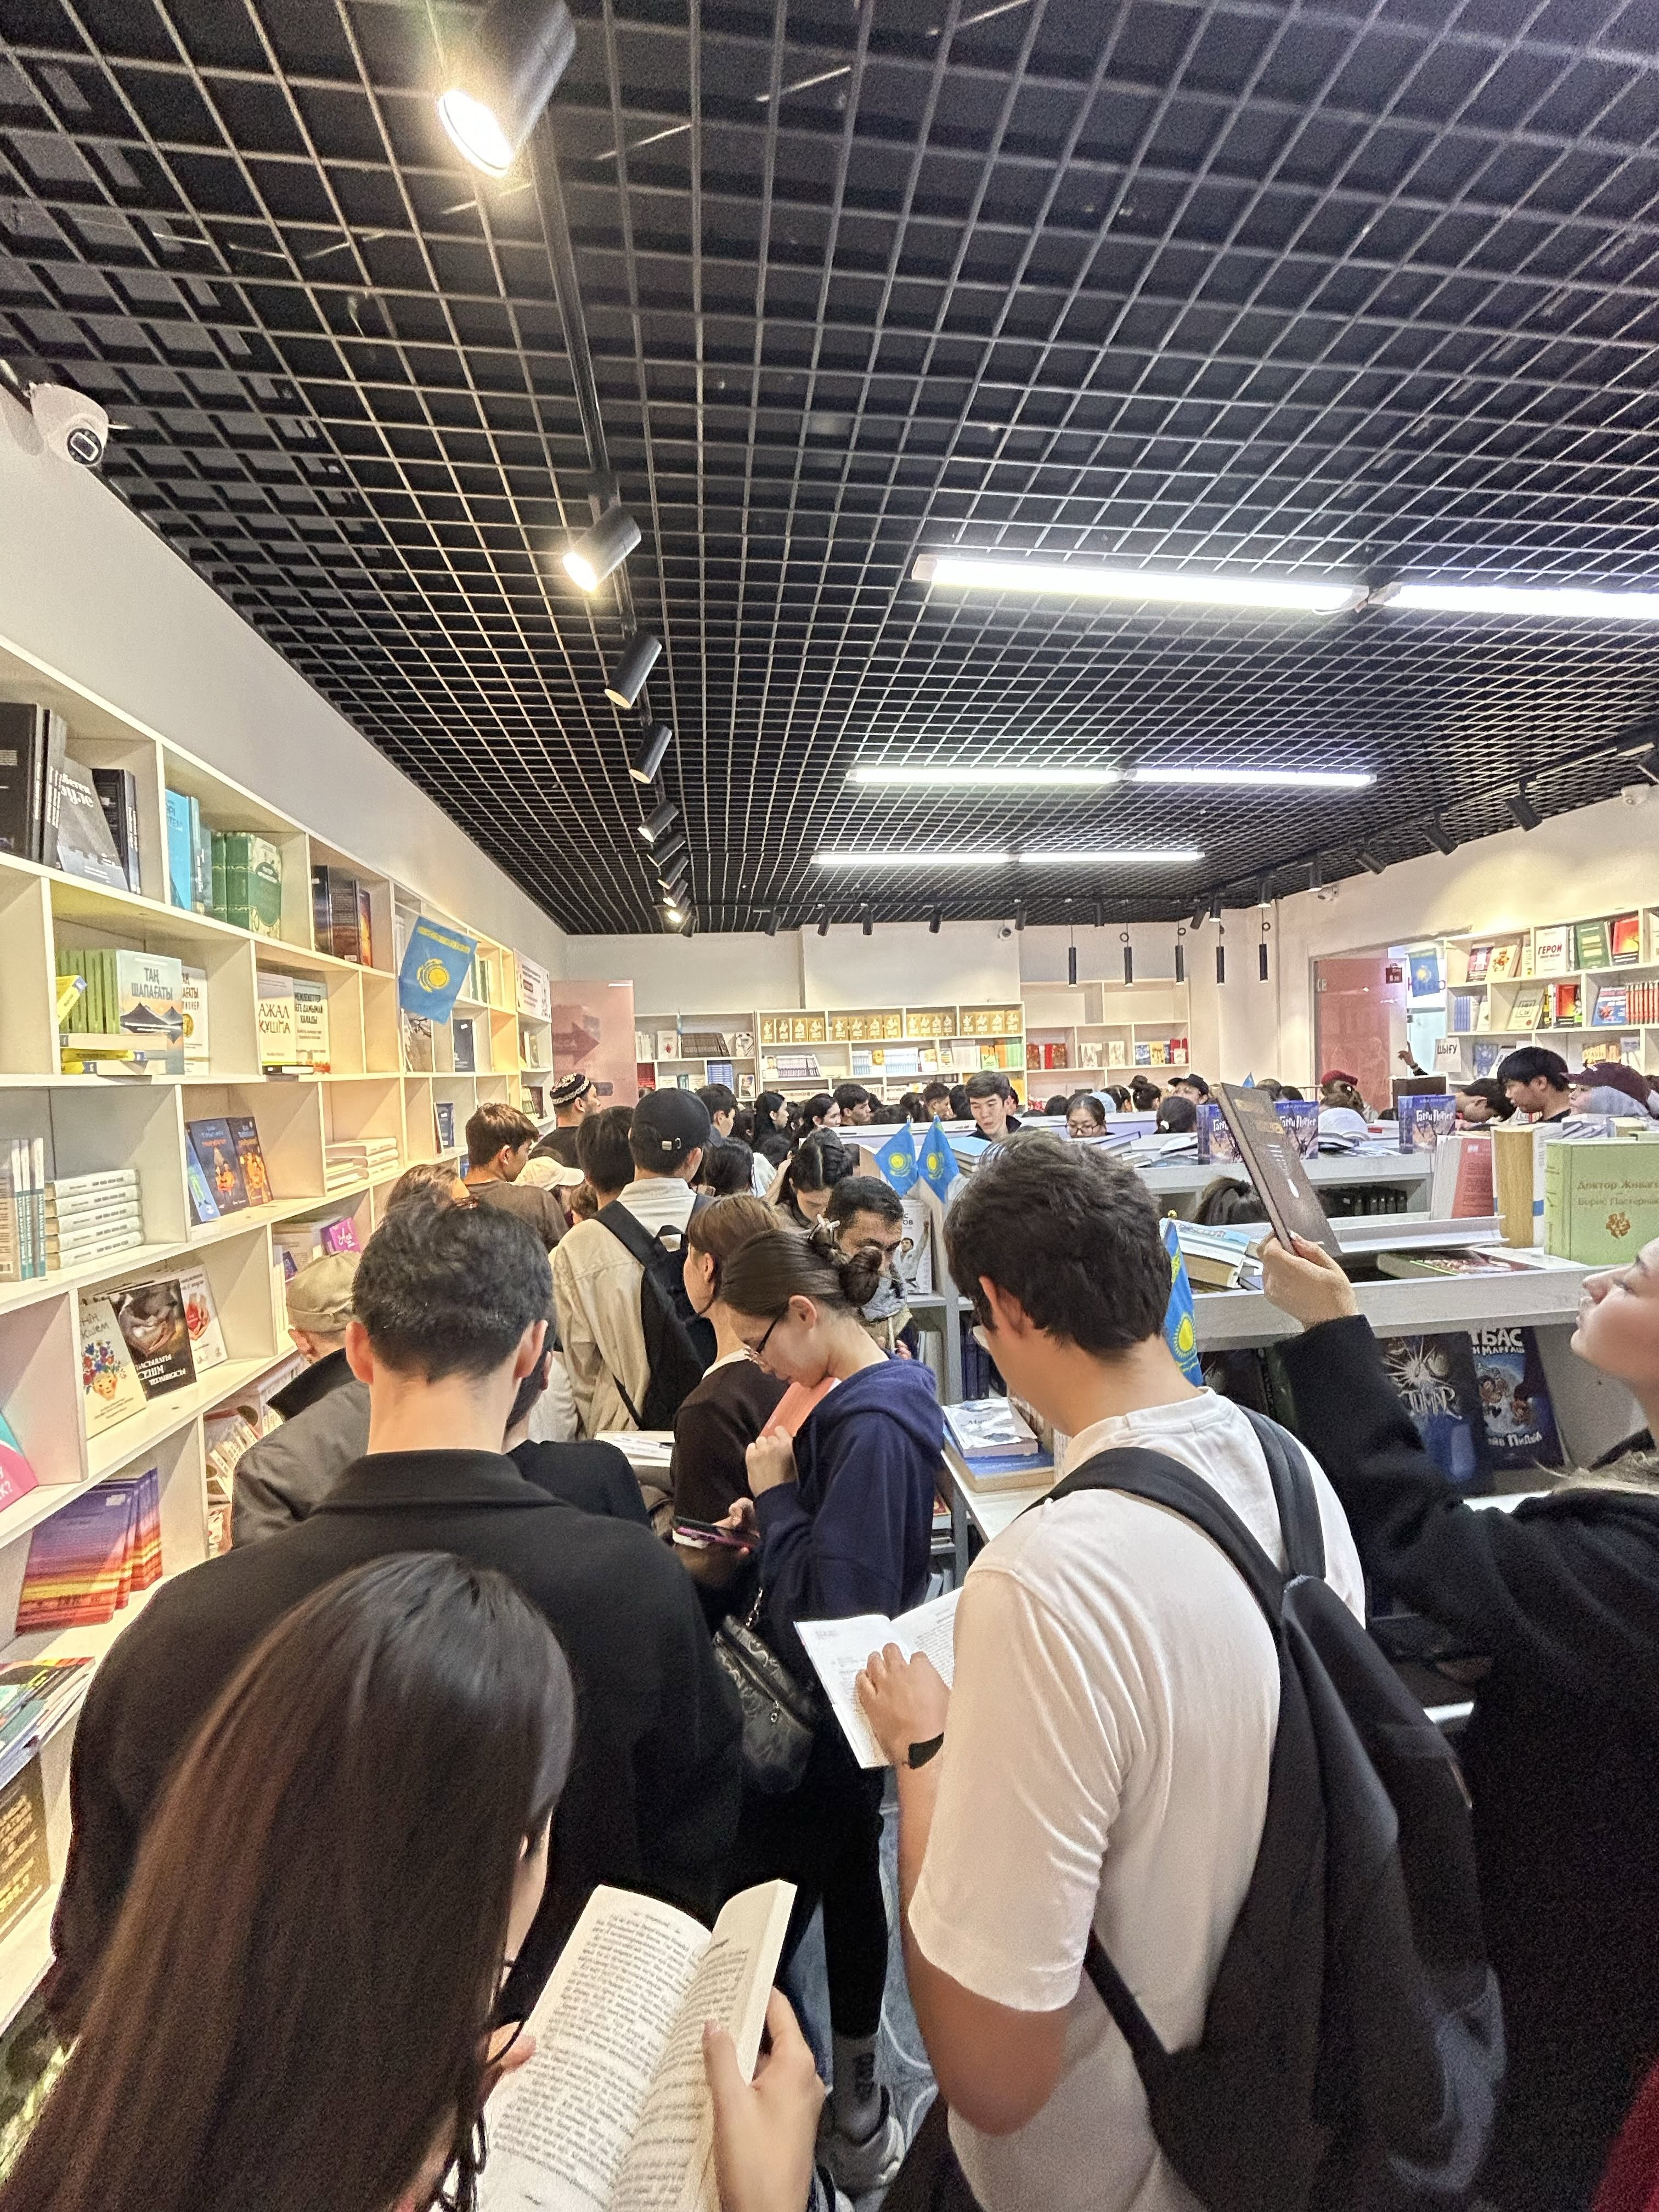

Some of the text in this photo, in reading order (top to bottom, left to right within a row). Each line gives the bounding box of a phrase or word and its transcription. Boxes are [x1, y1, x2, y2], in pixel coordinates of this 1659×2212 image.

[144, 967, 160, 984] ТАҢ
[182, 973, 190, 985] АҢ
[131, 983, 173, 1001] ШАПАҒАТЫ
[182, 987, 199, 999] АҒАТЫ
[258, 1003, 290, 1019] АЖАЛ
[1437, 1044, 1458, 1054] ШЫҒУ
[1577, 1180, 1659, 1191] Доктор Живаг
[1468, 1328, 1523, 1347] ТБАС
